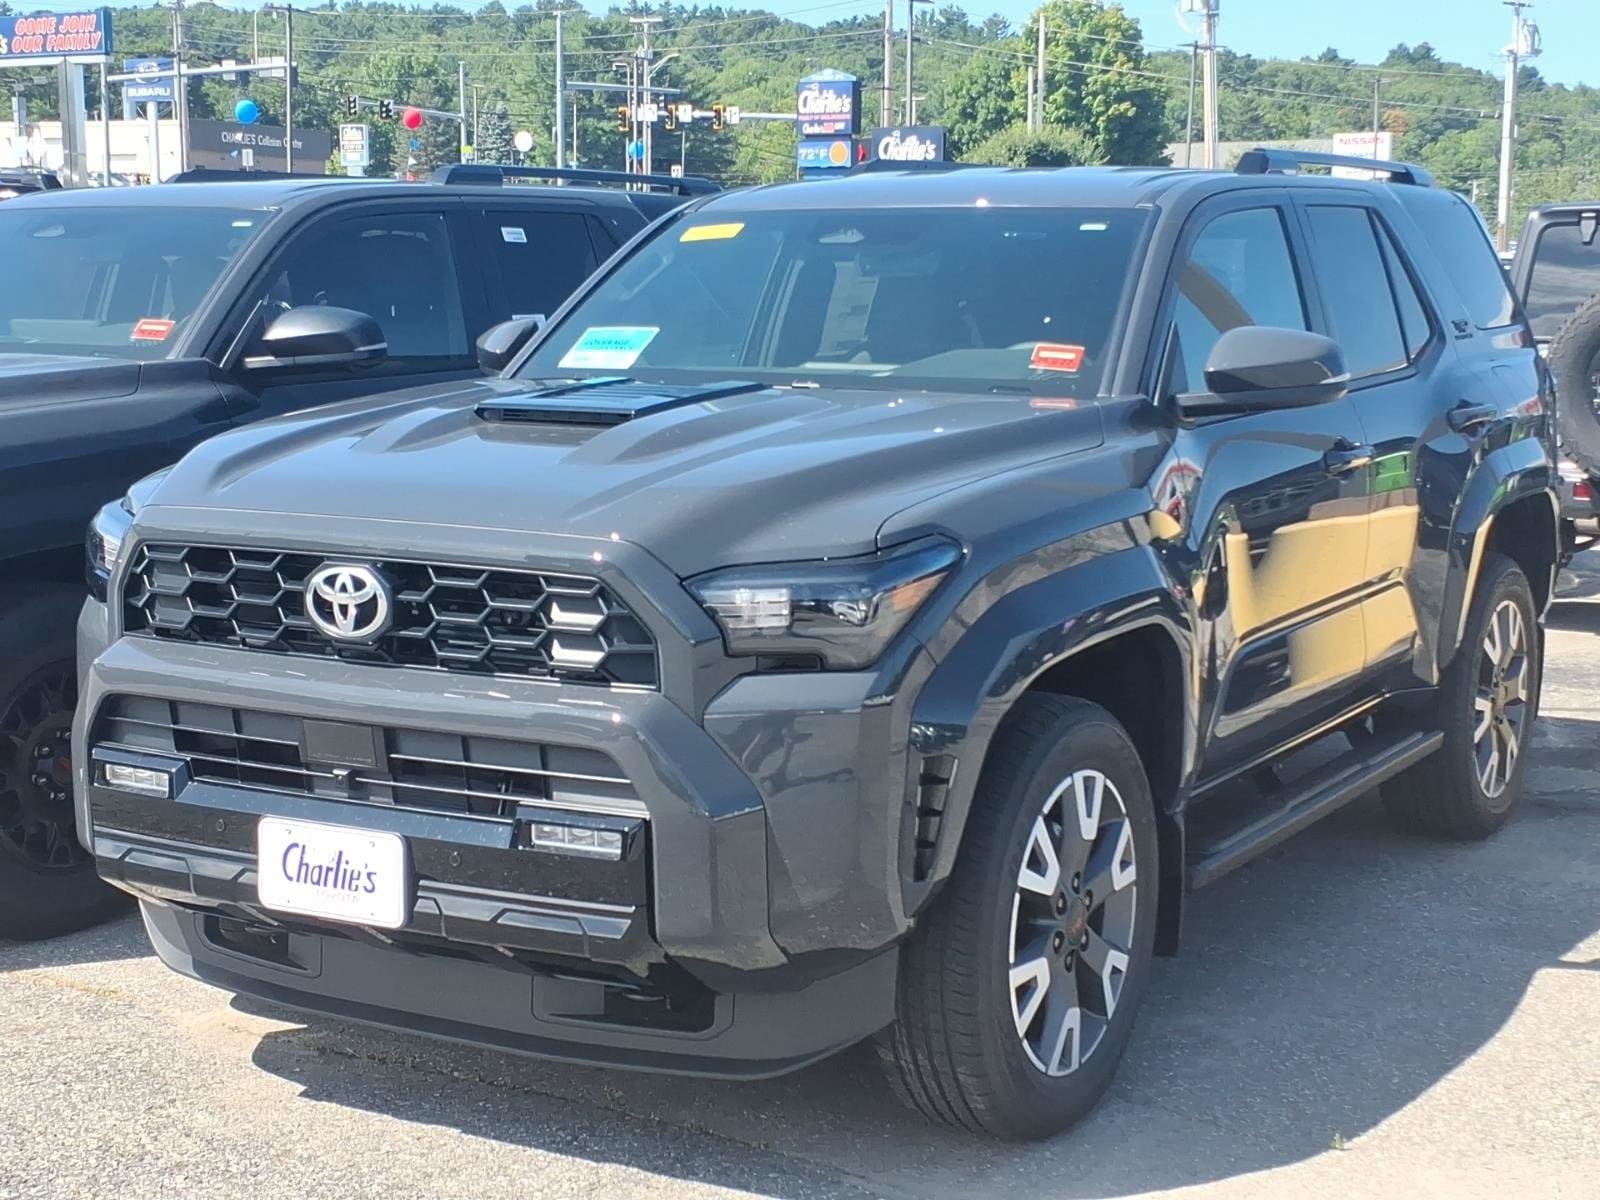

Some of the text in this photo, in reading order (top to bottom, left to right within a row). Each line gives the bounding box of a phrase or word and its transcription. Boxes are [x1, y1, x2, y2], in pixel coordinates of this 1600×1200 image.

[14, 13, 97, 36] COME JOIN
[11, 34, 44, 53] OUR
[46, 31, 102, 52] FAMILY
[127, 87, 171, 97] SUBARU
[798, 84, 851, 114] Charlie's
[878, 130, 936, 161] Charlie's
[1338, 137, 1385, 145] NISSAN
[282, 842, 377, 893] Charlie's
